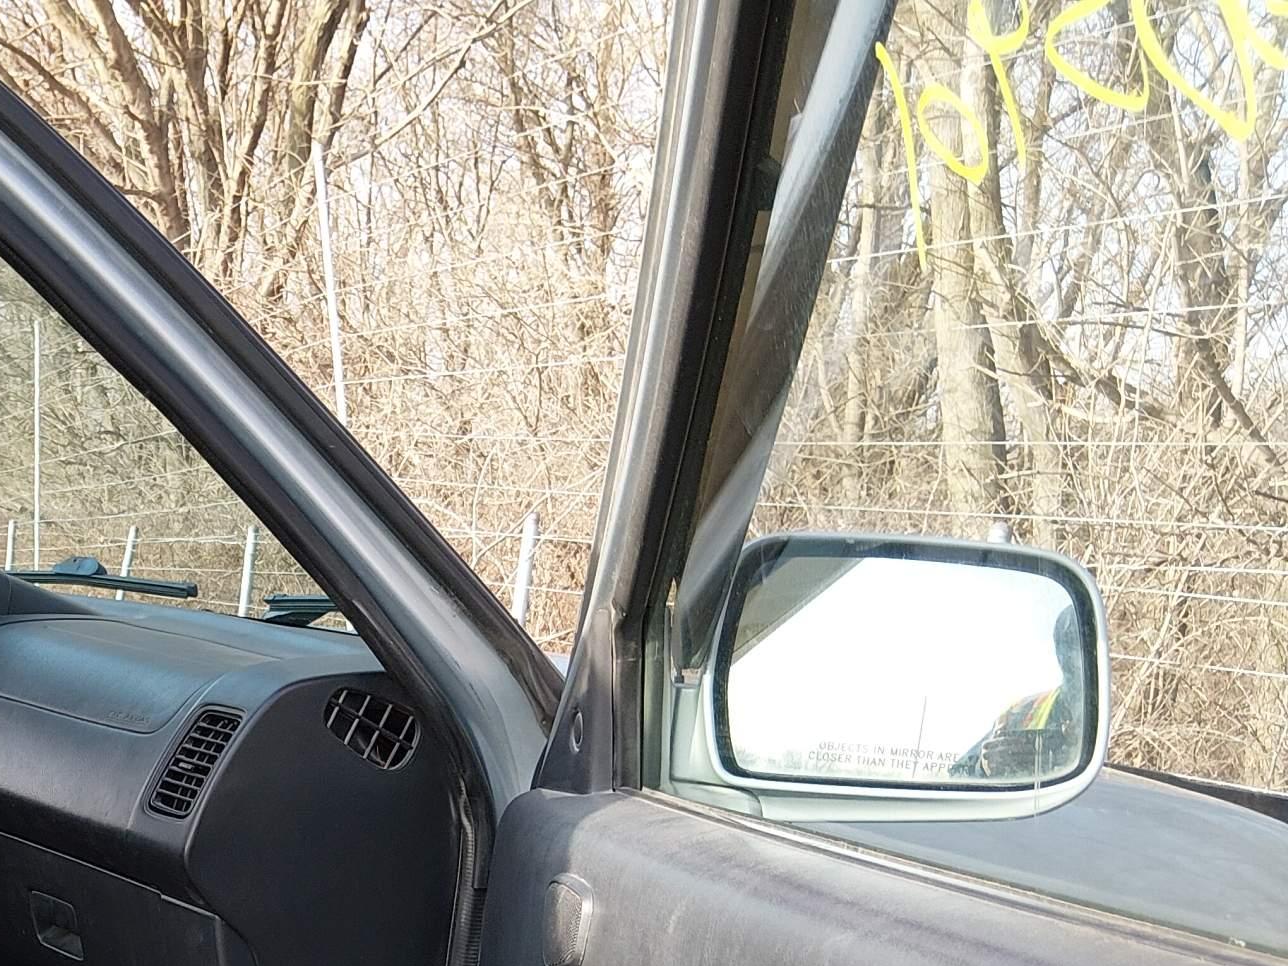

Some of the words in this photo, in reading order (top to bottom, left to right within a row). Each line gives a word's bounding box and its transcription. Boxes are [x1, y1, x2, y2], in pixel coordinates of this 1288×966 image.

[808, 750, 852, 764] CLOSER
[857, 754, 886, 767] THAN
[818, 741, 869, 755] OBJECTS
[873, 743, 885, 755] IN
[890, 747, 934, 760] MIRROR
[936, 751, 961, 763] ARE
